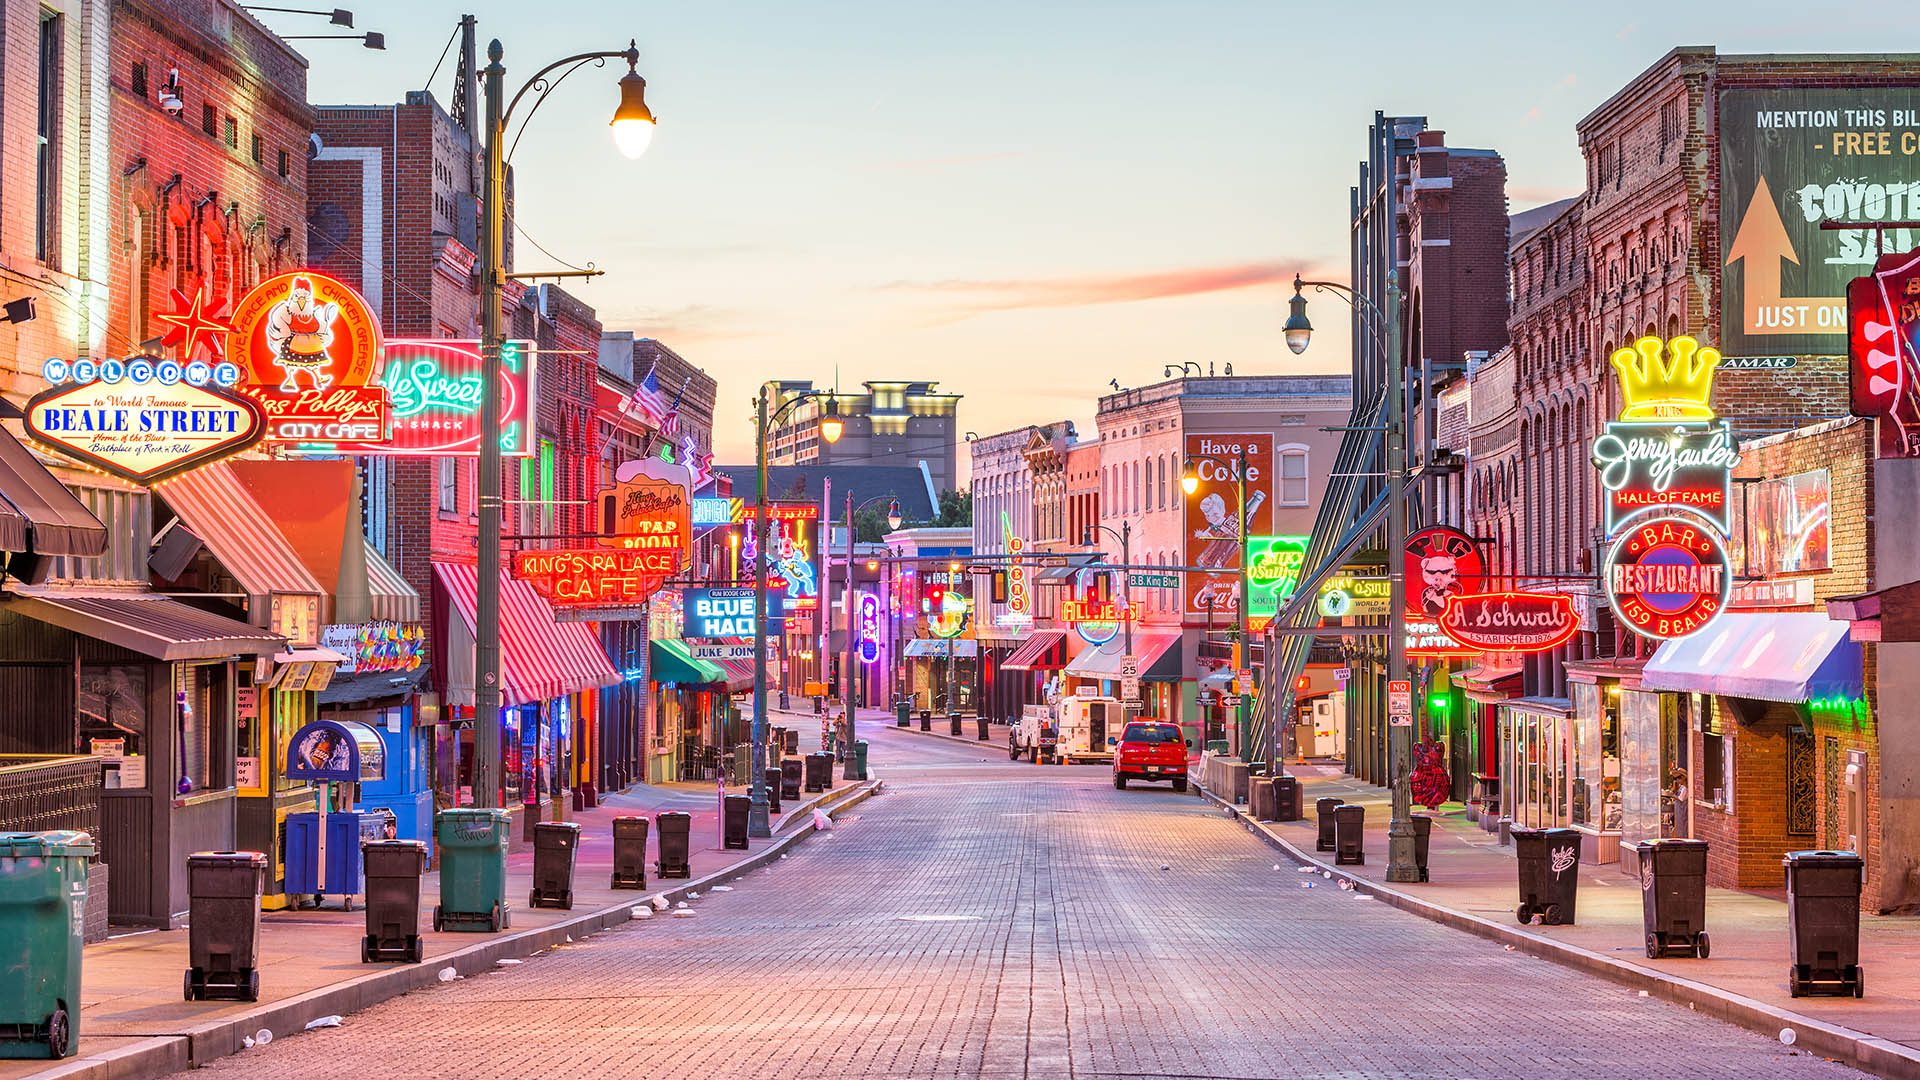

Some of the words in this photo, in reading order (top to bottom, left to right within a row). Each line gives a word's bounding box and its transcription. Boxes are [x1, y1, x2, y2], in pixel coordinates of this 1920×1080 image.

[1757, 110, 1838, 128] MENTION
[1845, 110, 1886, 127] THIS
[1833, 132, 1891, 155] FREE
[1901, 132, 1920, 155] C
[1799, 182, 1920, 222] COYOTE
[1755, 306, 1810, 328] JUST
[239, 297, 266, 332] PEACE
[265, 282, 289, 299] AND
[322, 285, 361, 325] CHICKEN
[353, 327, 369, 376] GREASE
[45, 361, 237, 384] WELCOME
[94, 398, 104, 406] to
[107, 395, 142, 407] World
[147, 396, 187, 408] Famous
[44, 409, 129, 431] BEALE
[139, 410, 240, 433] STREET
[280, 423, 322, 438] CITY
[325, 423, 379, 438] CAFE
[410, 421, 463, 430] SHACK
[92, 433, 118, 442] Home
[120, 434, 128, 443] of
[129, 433, 143, 442] the
[144, 433, 167, 442] Blues
[1200, 440, 1240, 454] Have
[1248, 443, 1258, 454] a
[88, 443, 131, 455] Birthplace
[134, 446, 142, 456] of
[171, 444, 193, 453] Roll
[1198, 459, 1260, 481] Coke
[1593, 434, 1667, 490] Jerry
[1618, 492, 1652, 503] HALL
[1657, 493, 1676, 502] OF
[1682, 492, 1721, 503] FAME
[640, 520, 677, 534] TAP
[1643, 523, 1695, 547] BAR
[524, 553, 583, 573] KING'S
[557, 577, 638, 597] CAFE
[1130, 575, 1146, 586] B.B.
[1146, 576, 1161, 587] King
[1613, 564, 1723, 594] RESTAURANT
[1477, 600, 1571, 627] Schwab
[1624, 600, 1650, 624] 159
[1659, 600, 1716, 634] BEALE
[1470, 634, 1533, 644] ESTABLISHED
[1535, 634, 1552, 643] 1876
[696, 648, 722, 657] JUKE
[1122, 666, 1136, 674] 25
